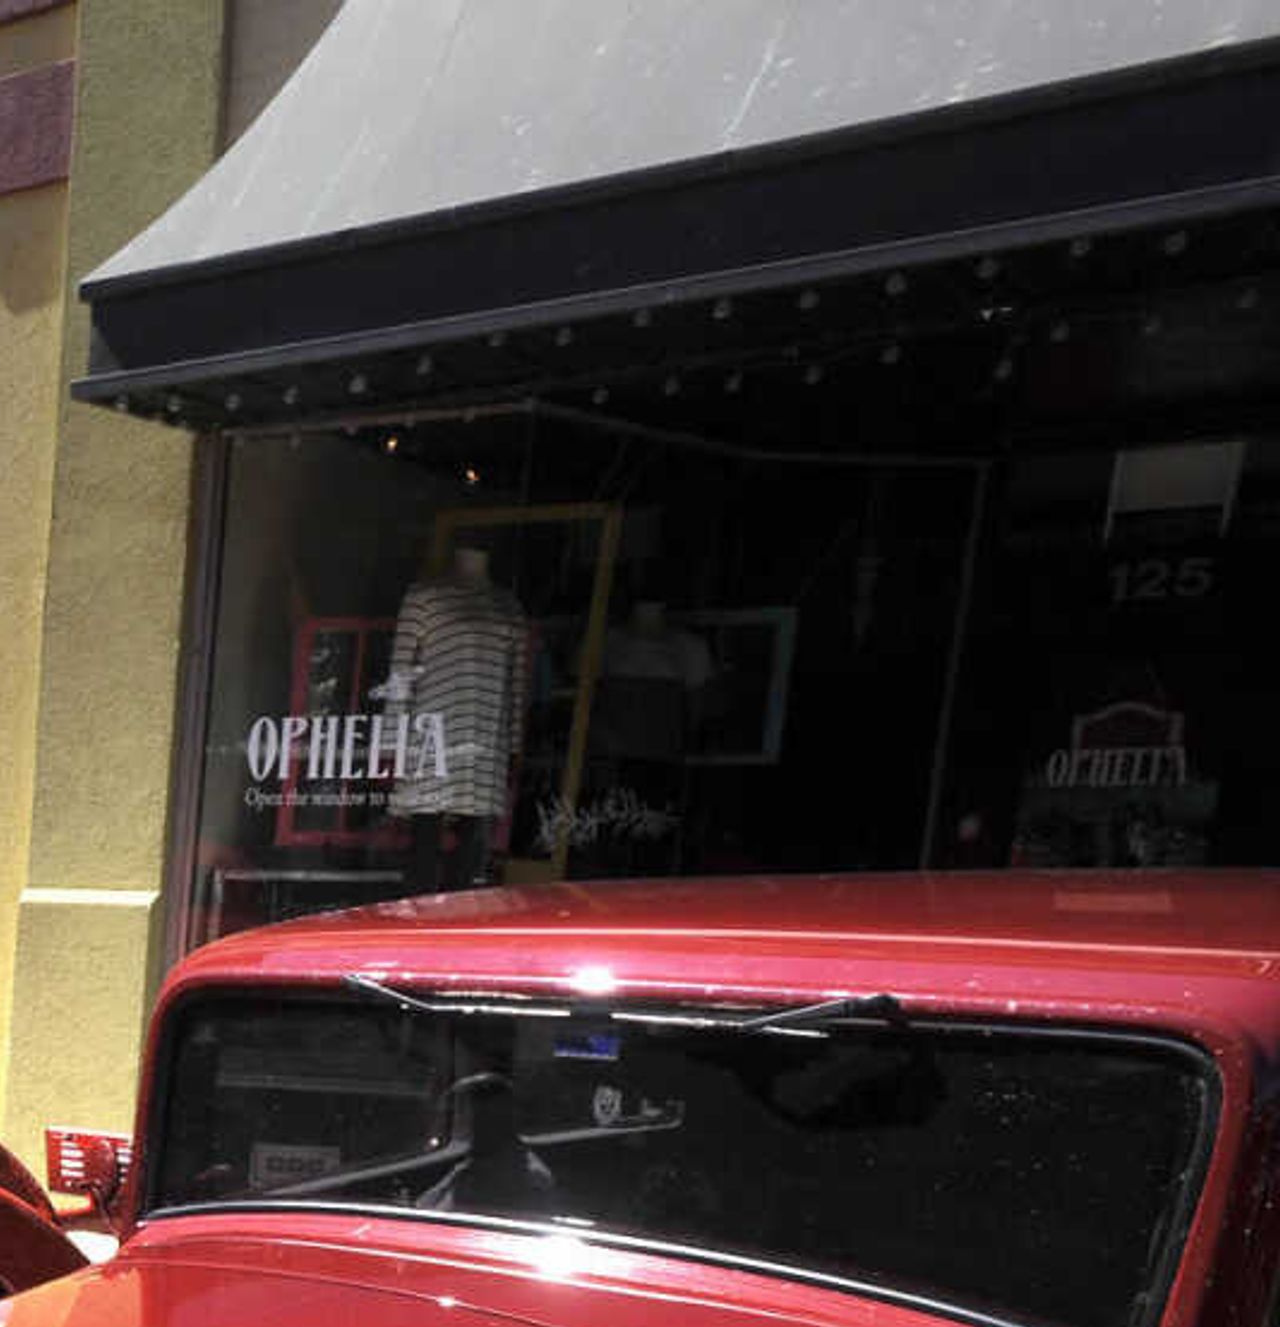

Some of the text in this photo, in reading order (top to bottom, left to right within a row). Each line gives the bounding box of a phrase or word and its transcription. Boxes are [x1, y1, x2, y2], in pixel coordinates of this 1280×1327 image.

[1110, 558, 1214, 602] 125
[248, 714, 447, 781] OPHELIA
[1048, 748, 1186, 787] OPHELIA
